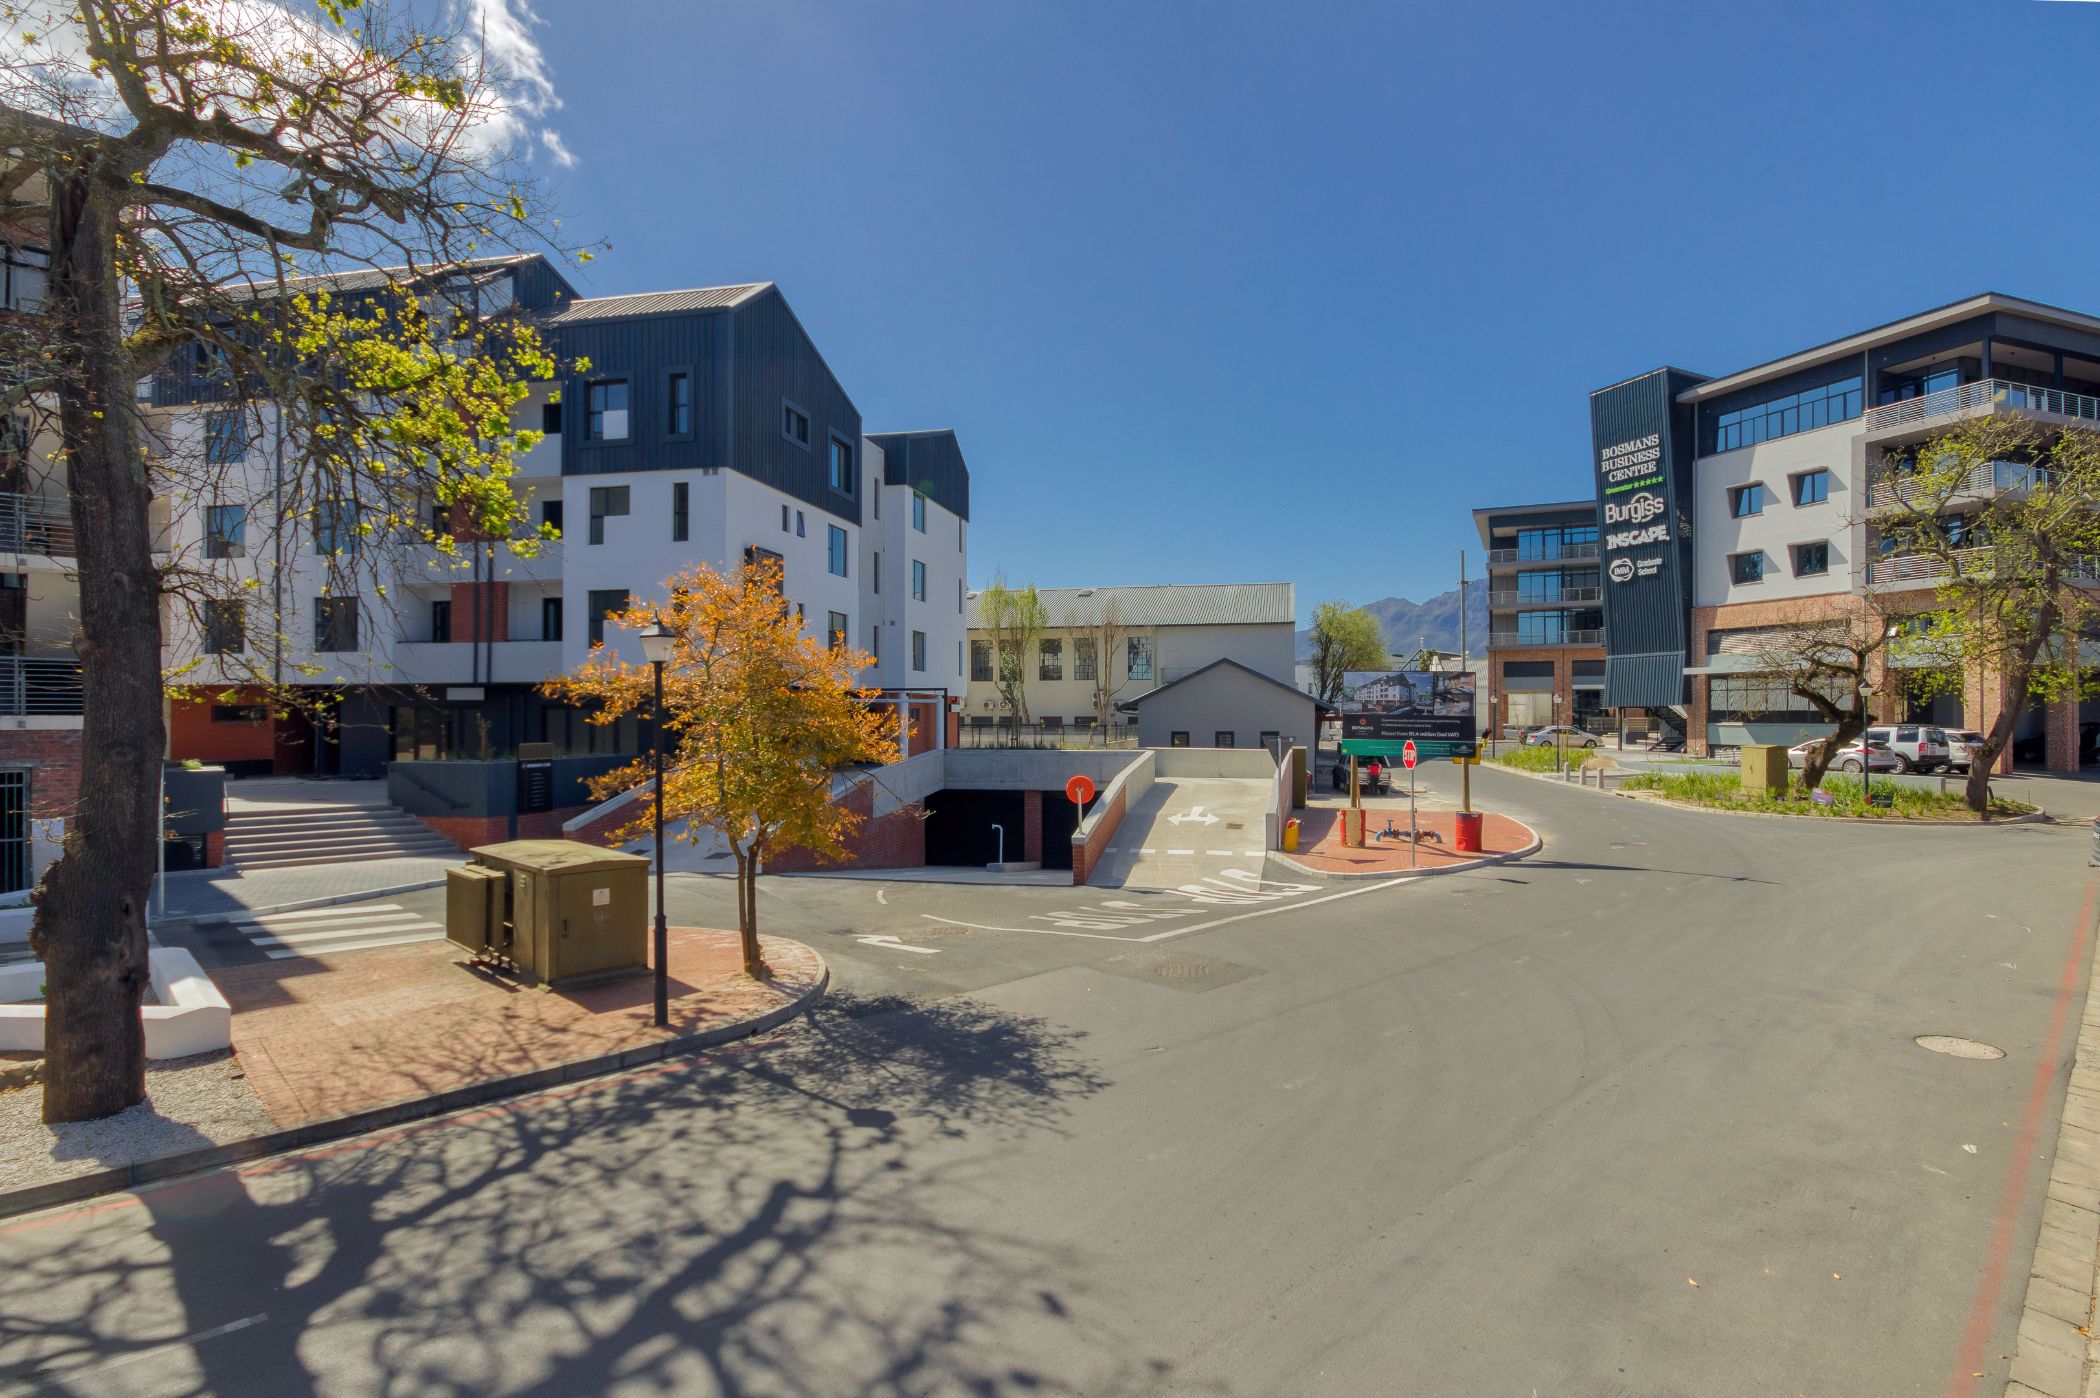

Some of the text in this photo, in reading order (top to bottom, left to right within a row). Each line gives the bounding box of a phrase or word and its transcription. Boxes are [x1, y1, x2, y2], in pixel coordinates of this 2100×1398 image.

[1602, 434, 1659, 460] BOSMANS
[1601, 447, 1660, 472] BUSINESS
[1609, 461, 1657, 482] CENTRE
[1605, 497, 1665, 524] Burgiss
[1637, 558, 1663, 568] Graduate
[1614, 566, 1630, 576] IMM
[1638, 566, 1657, 576] School
[1404, 750, 1416, 760] STOP
